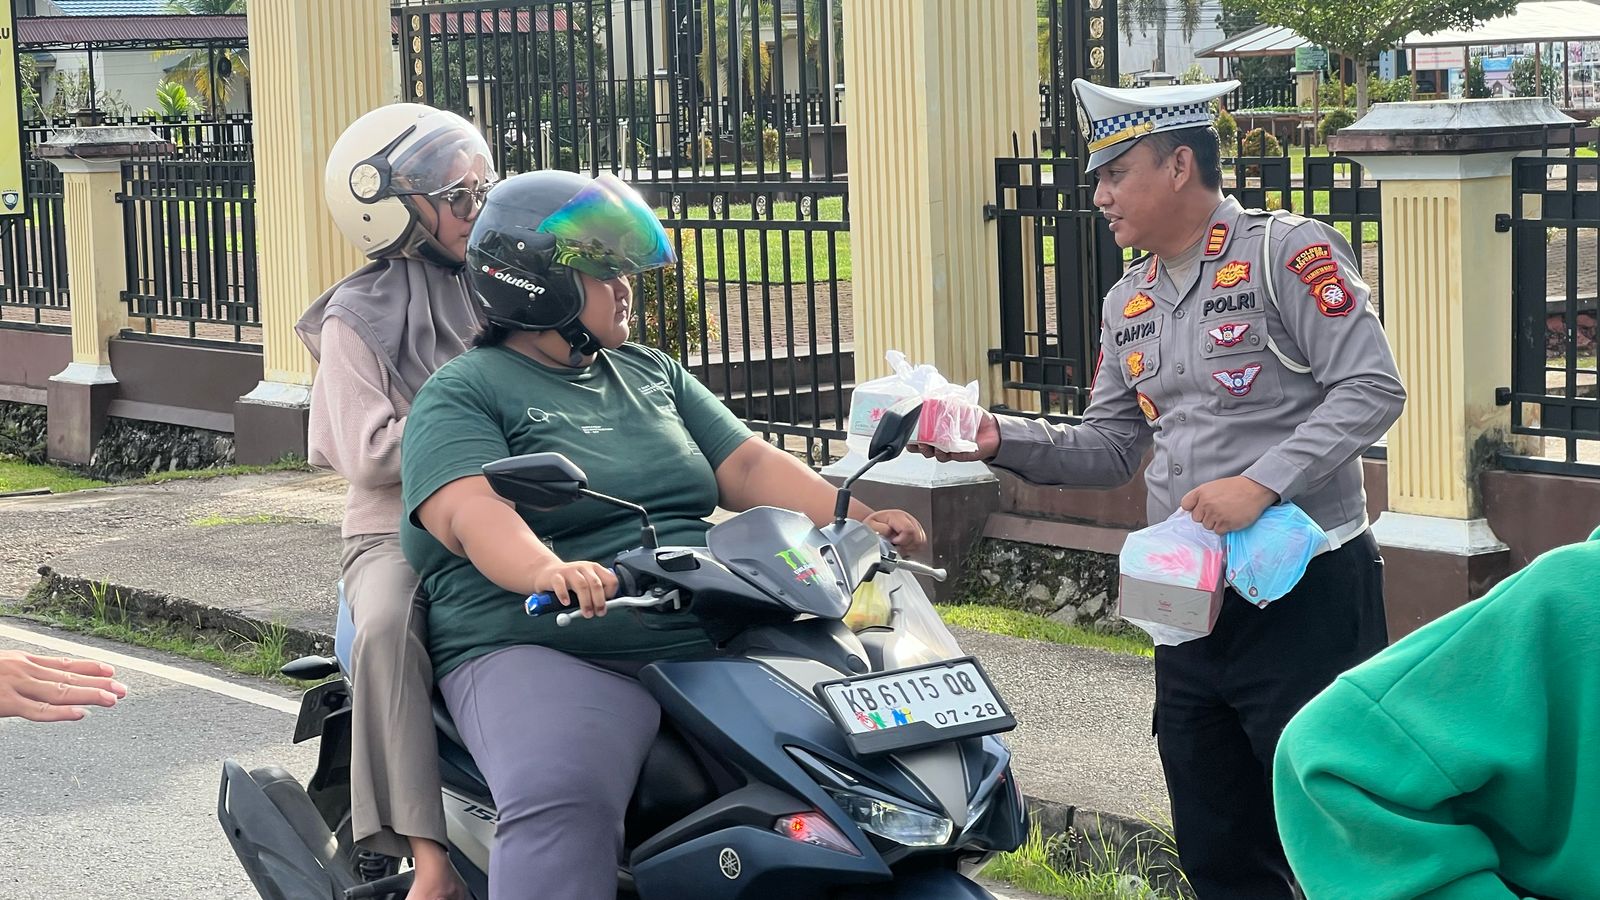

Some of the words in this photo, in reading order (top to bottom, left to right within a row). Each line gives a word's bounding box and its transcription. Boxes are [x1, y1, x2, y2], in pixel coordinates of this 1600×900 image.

[0, 28, 9, 39] U
[1203, 292, 1256, 316] POLRI
[1115, 321, 1156, 347] CAHYA
[841, 687, 878, 712] KB
[878, 676, 940, 706] 6115
